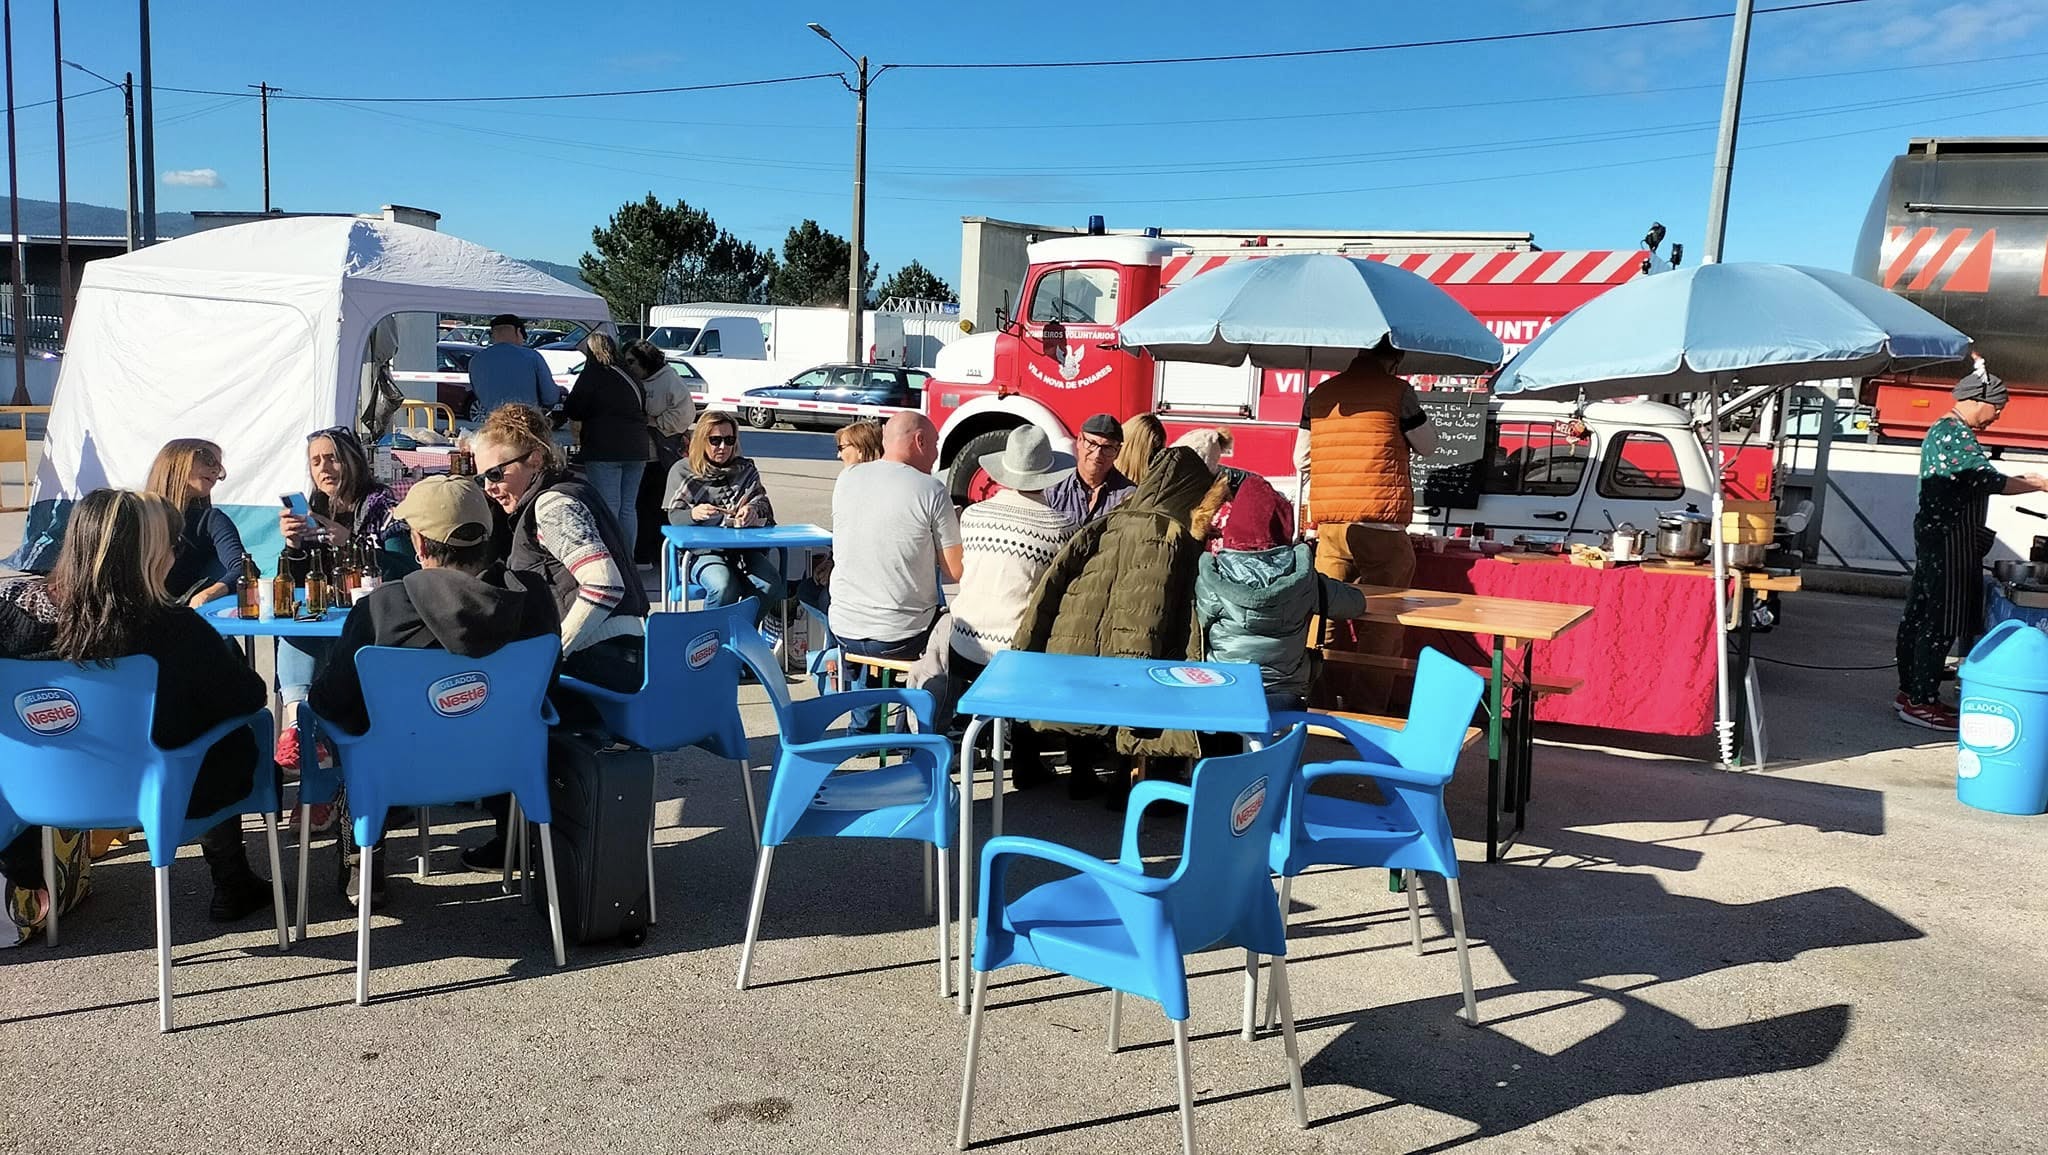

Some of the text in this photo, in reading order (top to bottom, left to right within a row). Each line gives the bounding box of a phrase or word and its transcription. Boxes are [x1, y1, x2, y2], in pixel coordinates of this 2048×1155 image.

[1485, 316, 1553, 340] UNTÁ
[1028, 362, 1113, 389] VILA NOVA DE POIARES
[1555, 422, 1569, 434] WEL
[440, 674, 478, 690] GELADOS
[23, 691, 61, 704] GELADOS
